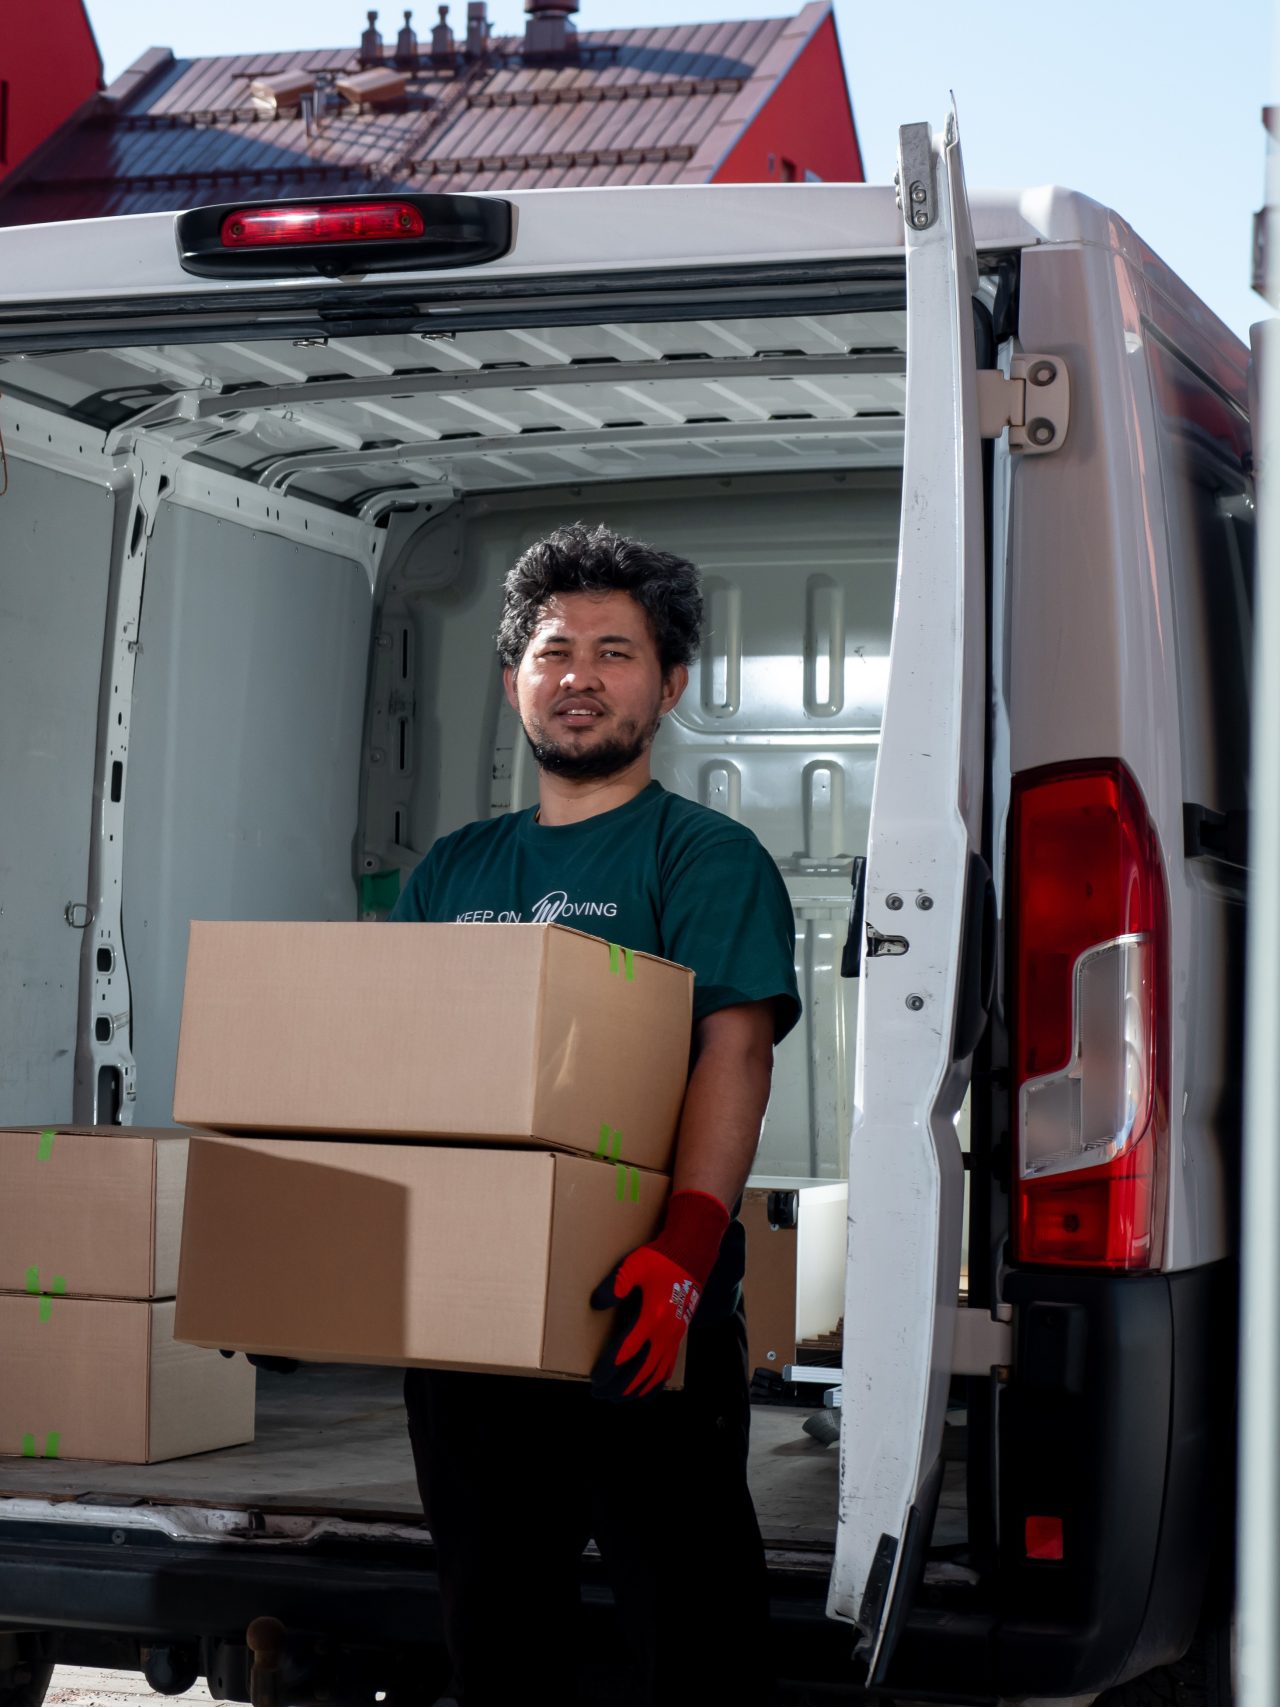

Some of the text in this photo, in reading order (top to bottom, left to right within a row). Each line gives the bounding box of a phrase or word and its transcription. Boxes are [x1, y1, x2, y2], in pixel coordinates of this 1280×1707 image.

[456, 890, 618, 923] KEEP ON MOVING
